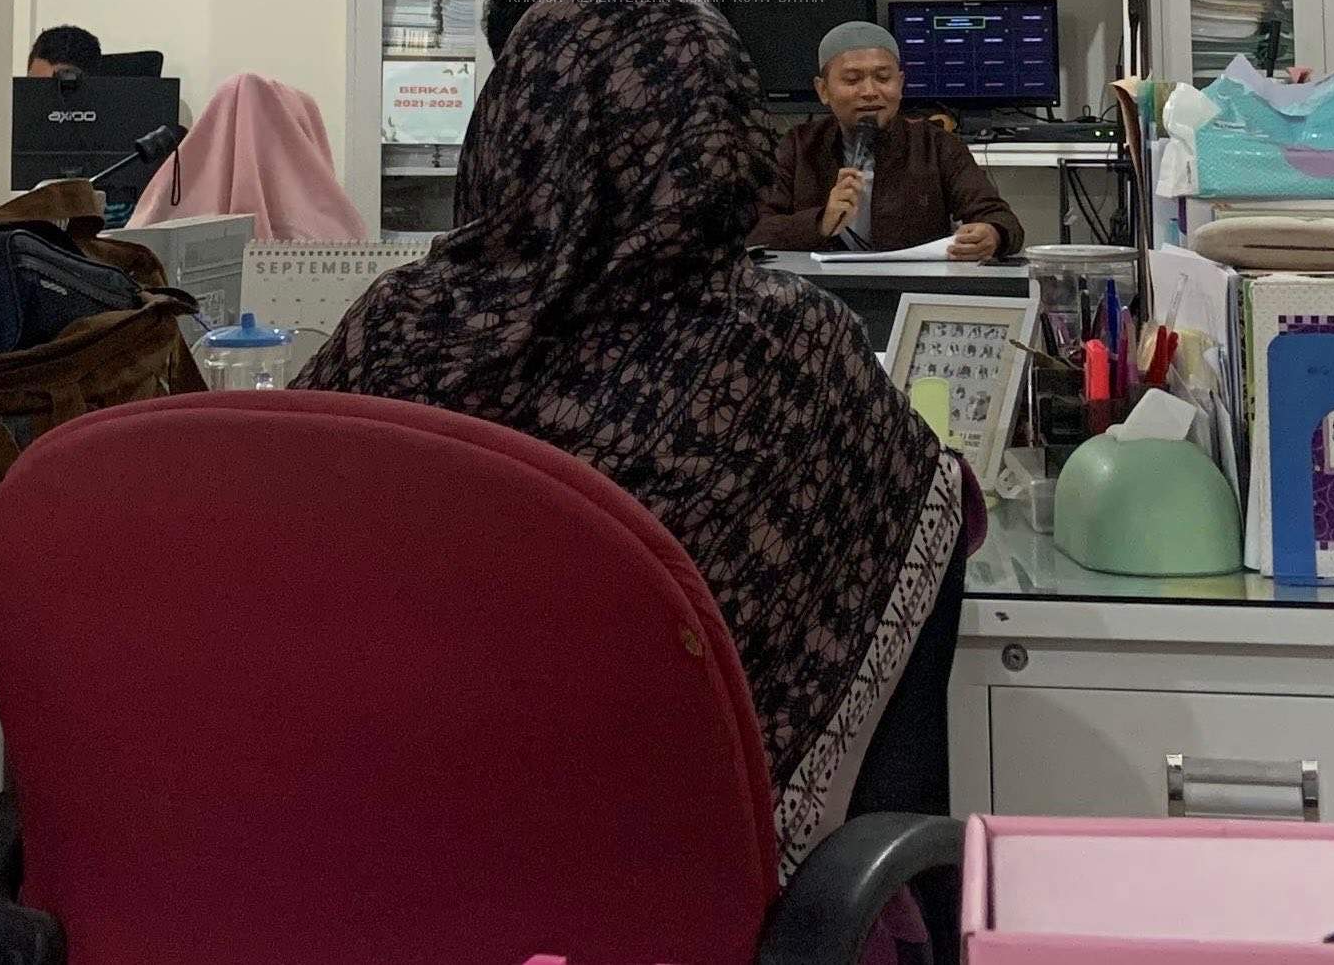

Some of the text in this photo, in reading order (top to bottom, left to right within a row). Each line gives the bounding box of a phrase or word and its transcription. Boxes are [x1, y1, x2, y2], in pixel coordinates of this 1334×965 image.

[399, 86, 458, 94] BERKAS
[394, 100, 463, 108] 2021-2022
[256, 261, 379, 275] SEPTEMBER
